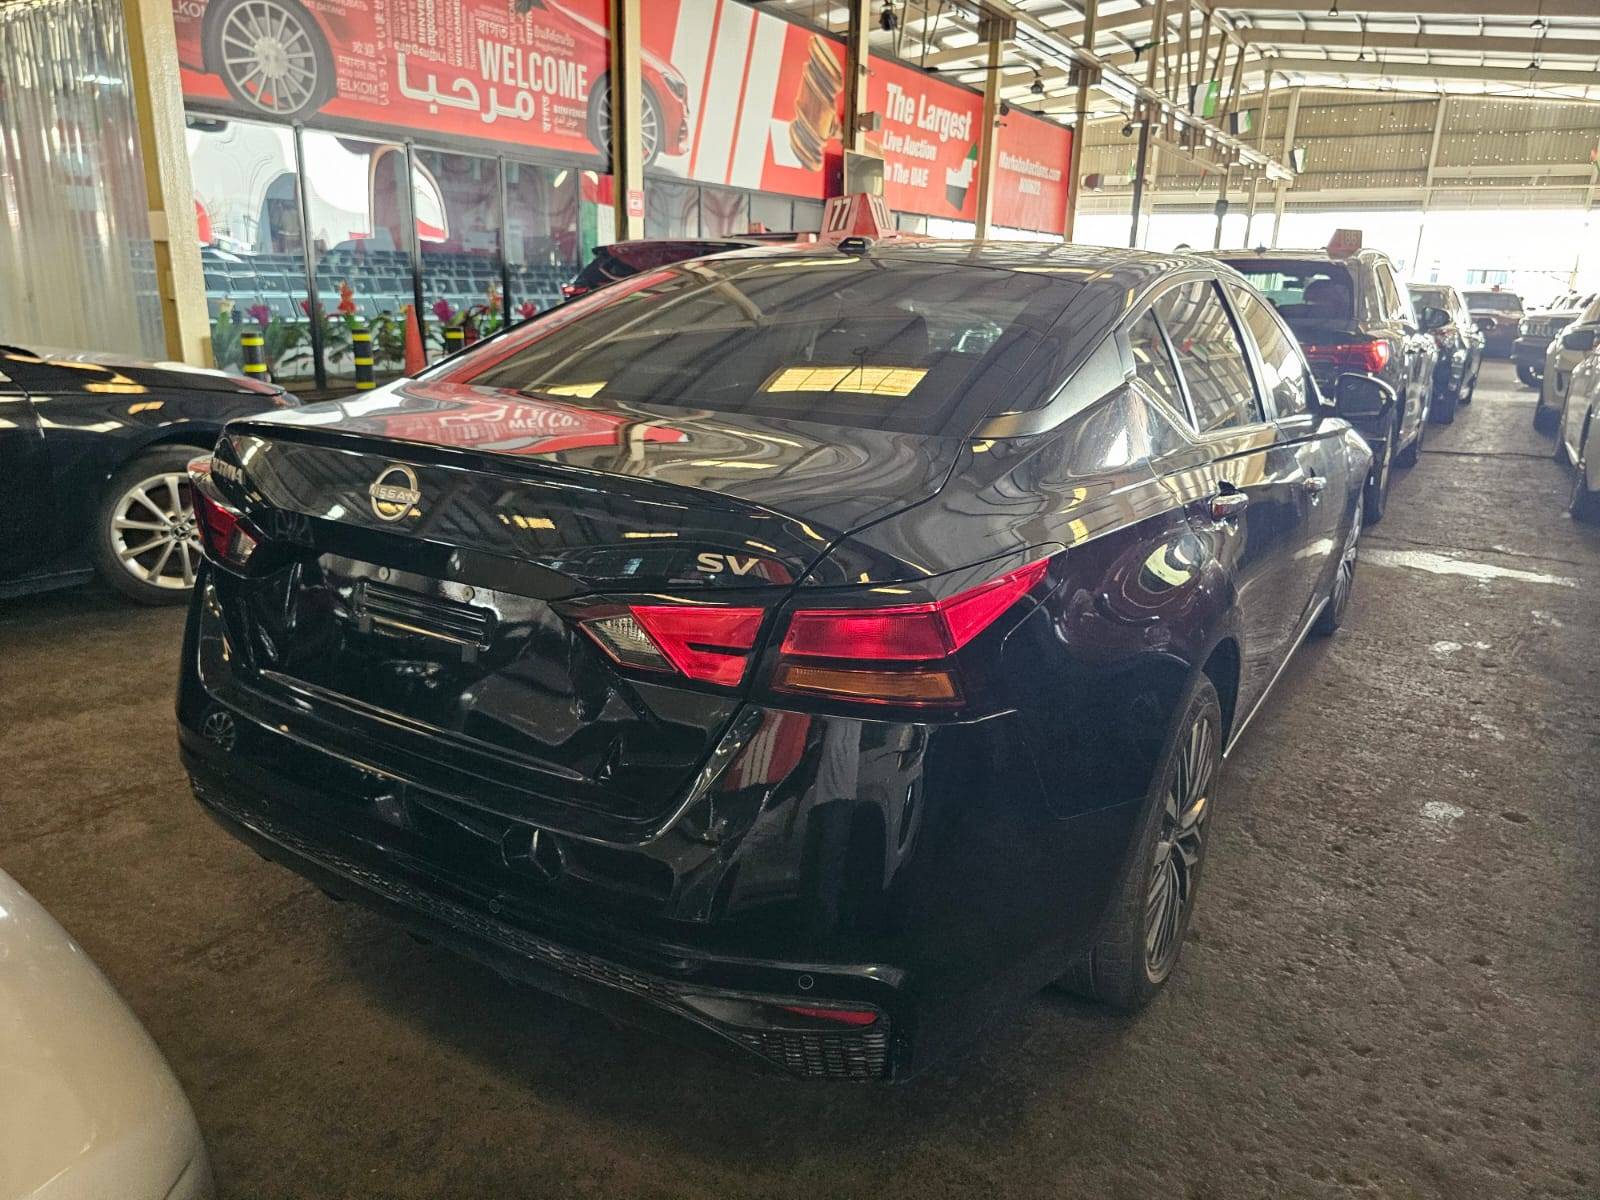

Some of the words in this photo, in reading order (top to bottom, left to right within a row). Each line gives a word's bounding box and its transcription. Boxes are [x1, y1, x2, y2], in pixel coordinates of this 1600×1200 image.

[478, 38, 588, 102] WELCOME
[397, 51, 536, 124] مرحبا
[885, 82, 915, 125] The
[917, 93, 972, 142] Largest
[883, 130, 903, 153] Live
[903, 134, 937, 161] Auction
[893, 162, 910, 185] The
[910, 166, 929, 188] UAE
[828, 198, 852, 232] 77
[371, 485, 420, 503] NISSAN
[696, 552, 760, 576] SV
